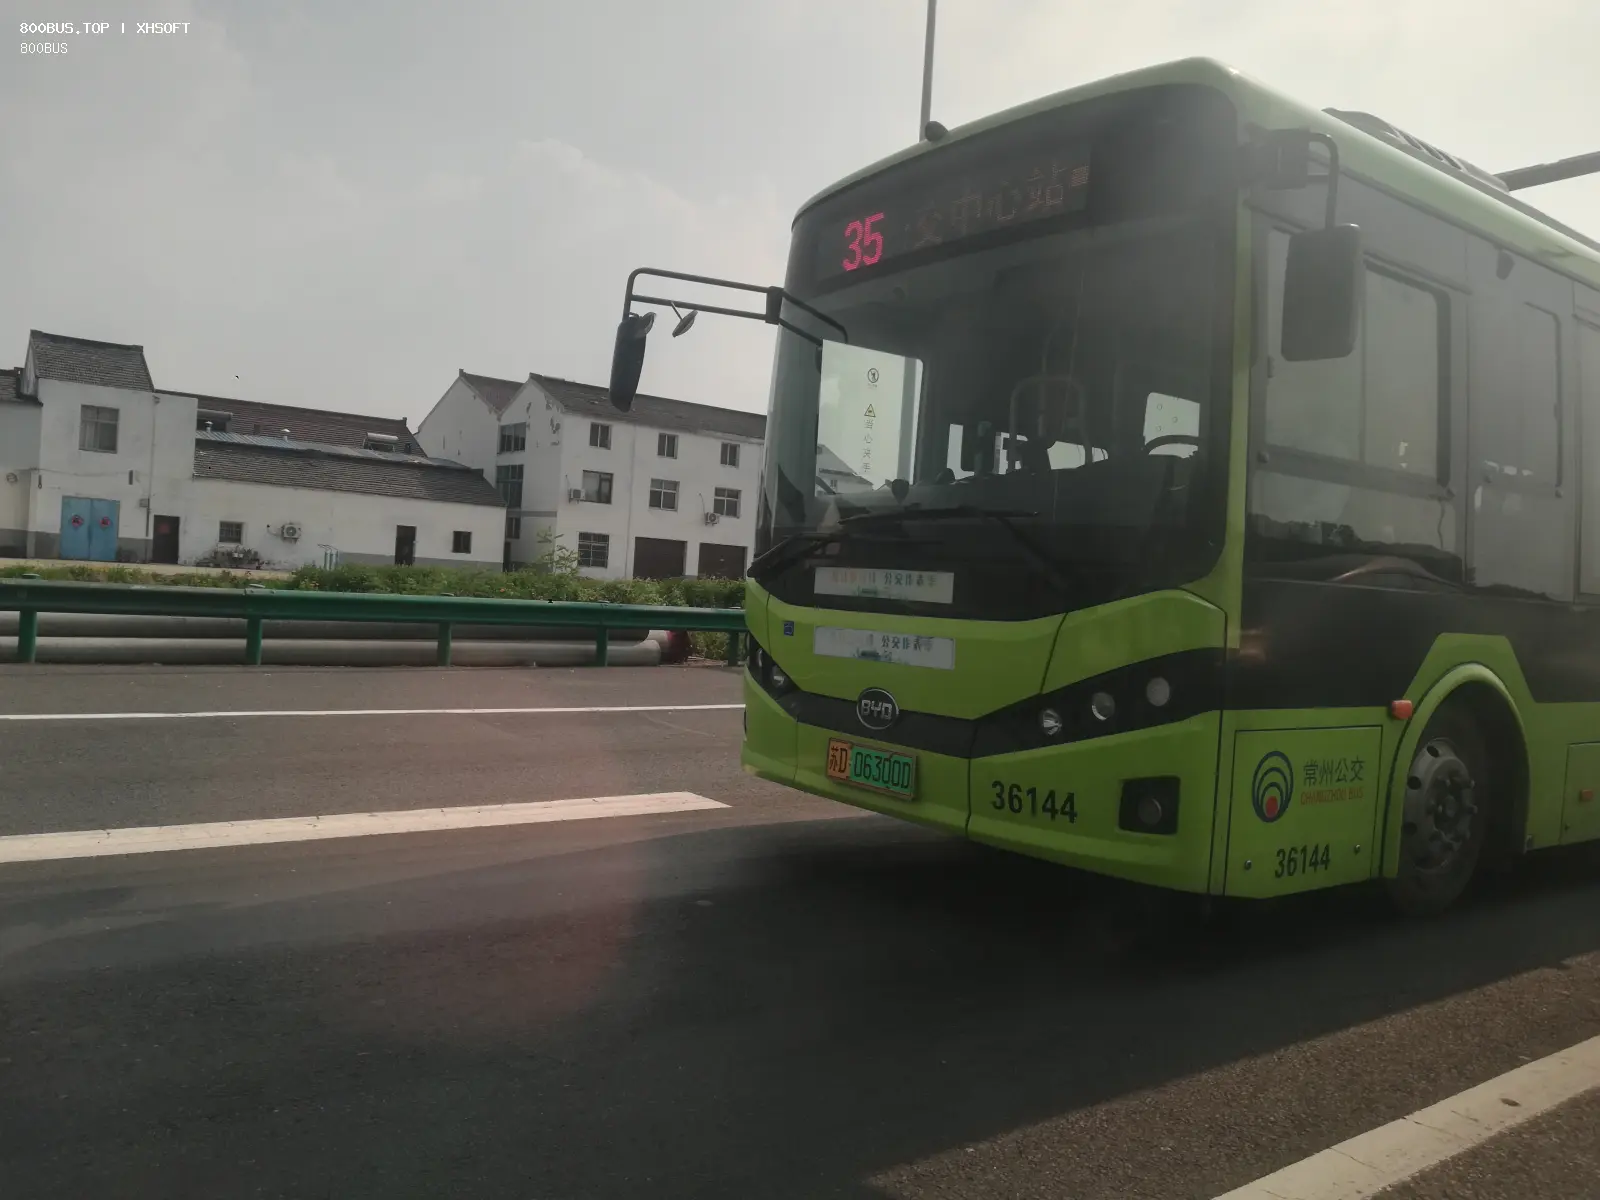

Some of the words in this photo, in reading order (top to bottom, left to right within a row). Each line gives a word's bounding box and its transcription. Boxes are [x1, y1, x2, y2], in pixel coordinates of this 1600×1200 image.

[842, 212, 884, 271] 35
[861, 699, 893, 721] BYD
[1303, 755, 1366, 787] 常州公交
[991, 780, 1077, 823] 36144
[1275, 844, 1330, 878] 36144
